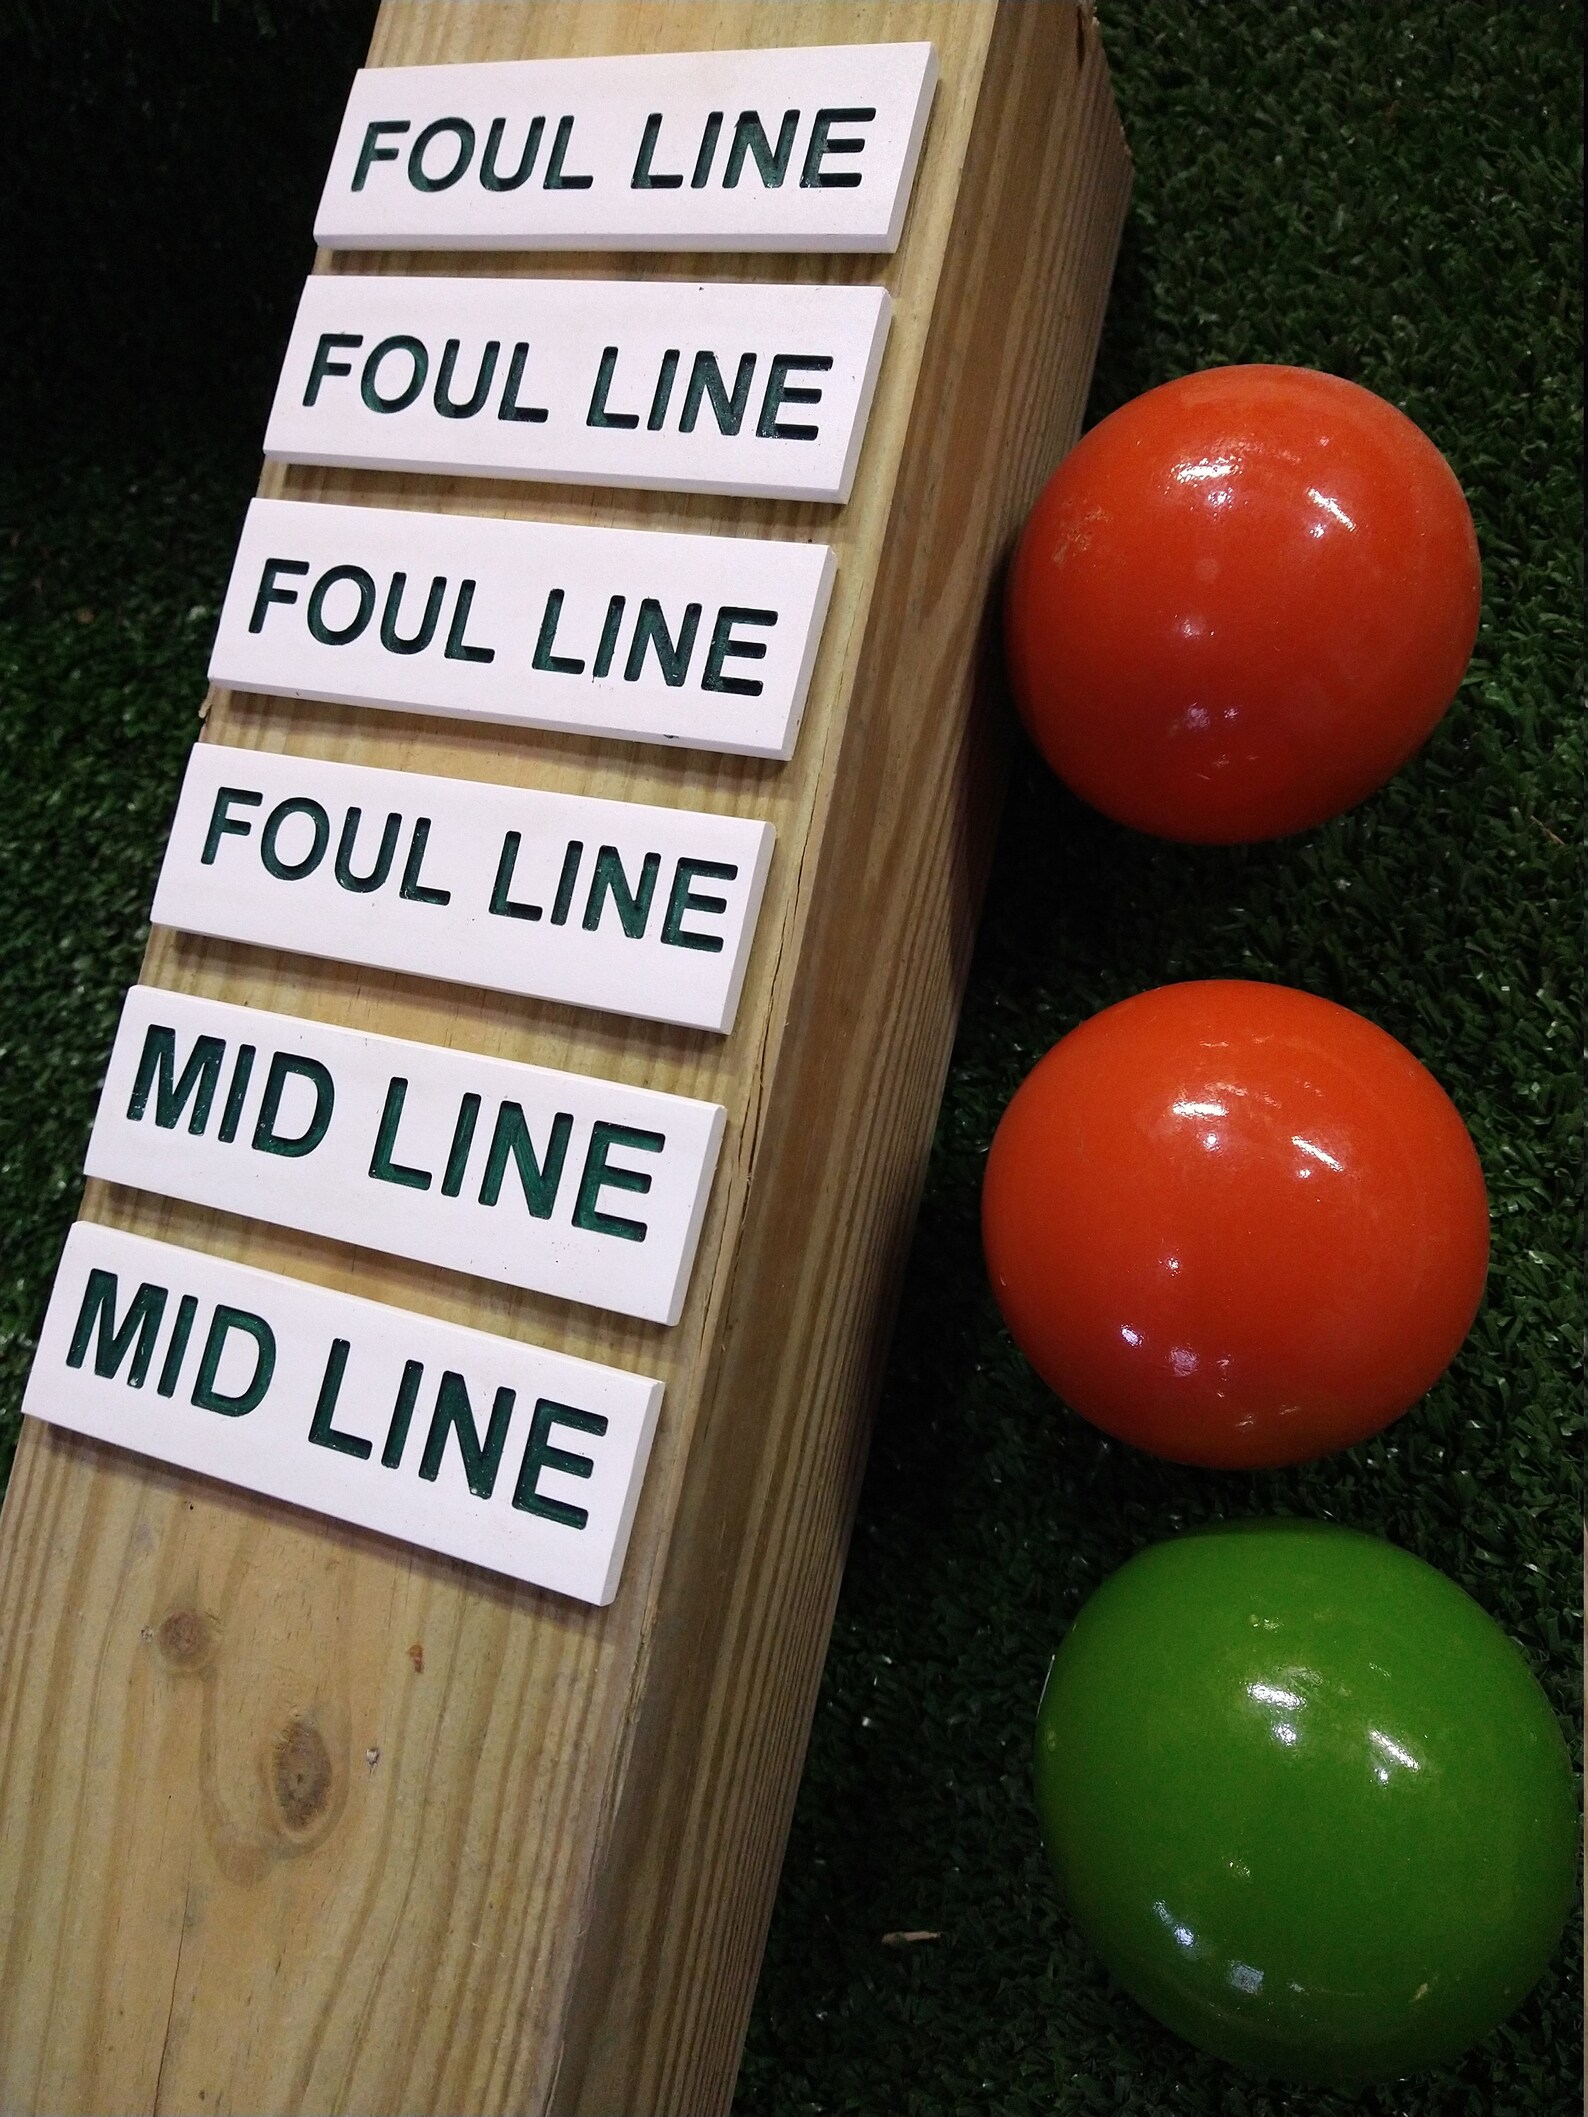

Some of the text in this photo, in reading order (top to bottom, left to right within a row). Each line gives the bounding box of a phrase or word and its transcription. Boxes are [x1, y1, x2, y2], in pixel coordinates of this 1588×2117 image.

[351, 108, 876, 192] FOUL LINE
[303, 333, 833, 441] FOUL LINE
[248, 558, 778, 696] FOUL LINE
[201, 787, 738, 952] FOUL LINE
[127, 1024, 665, 1242] MID LINE
[66, 1268, 608, 1530] MID LINE
